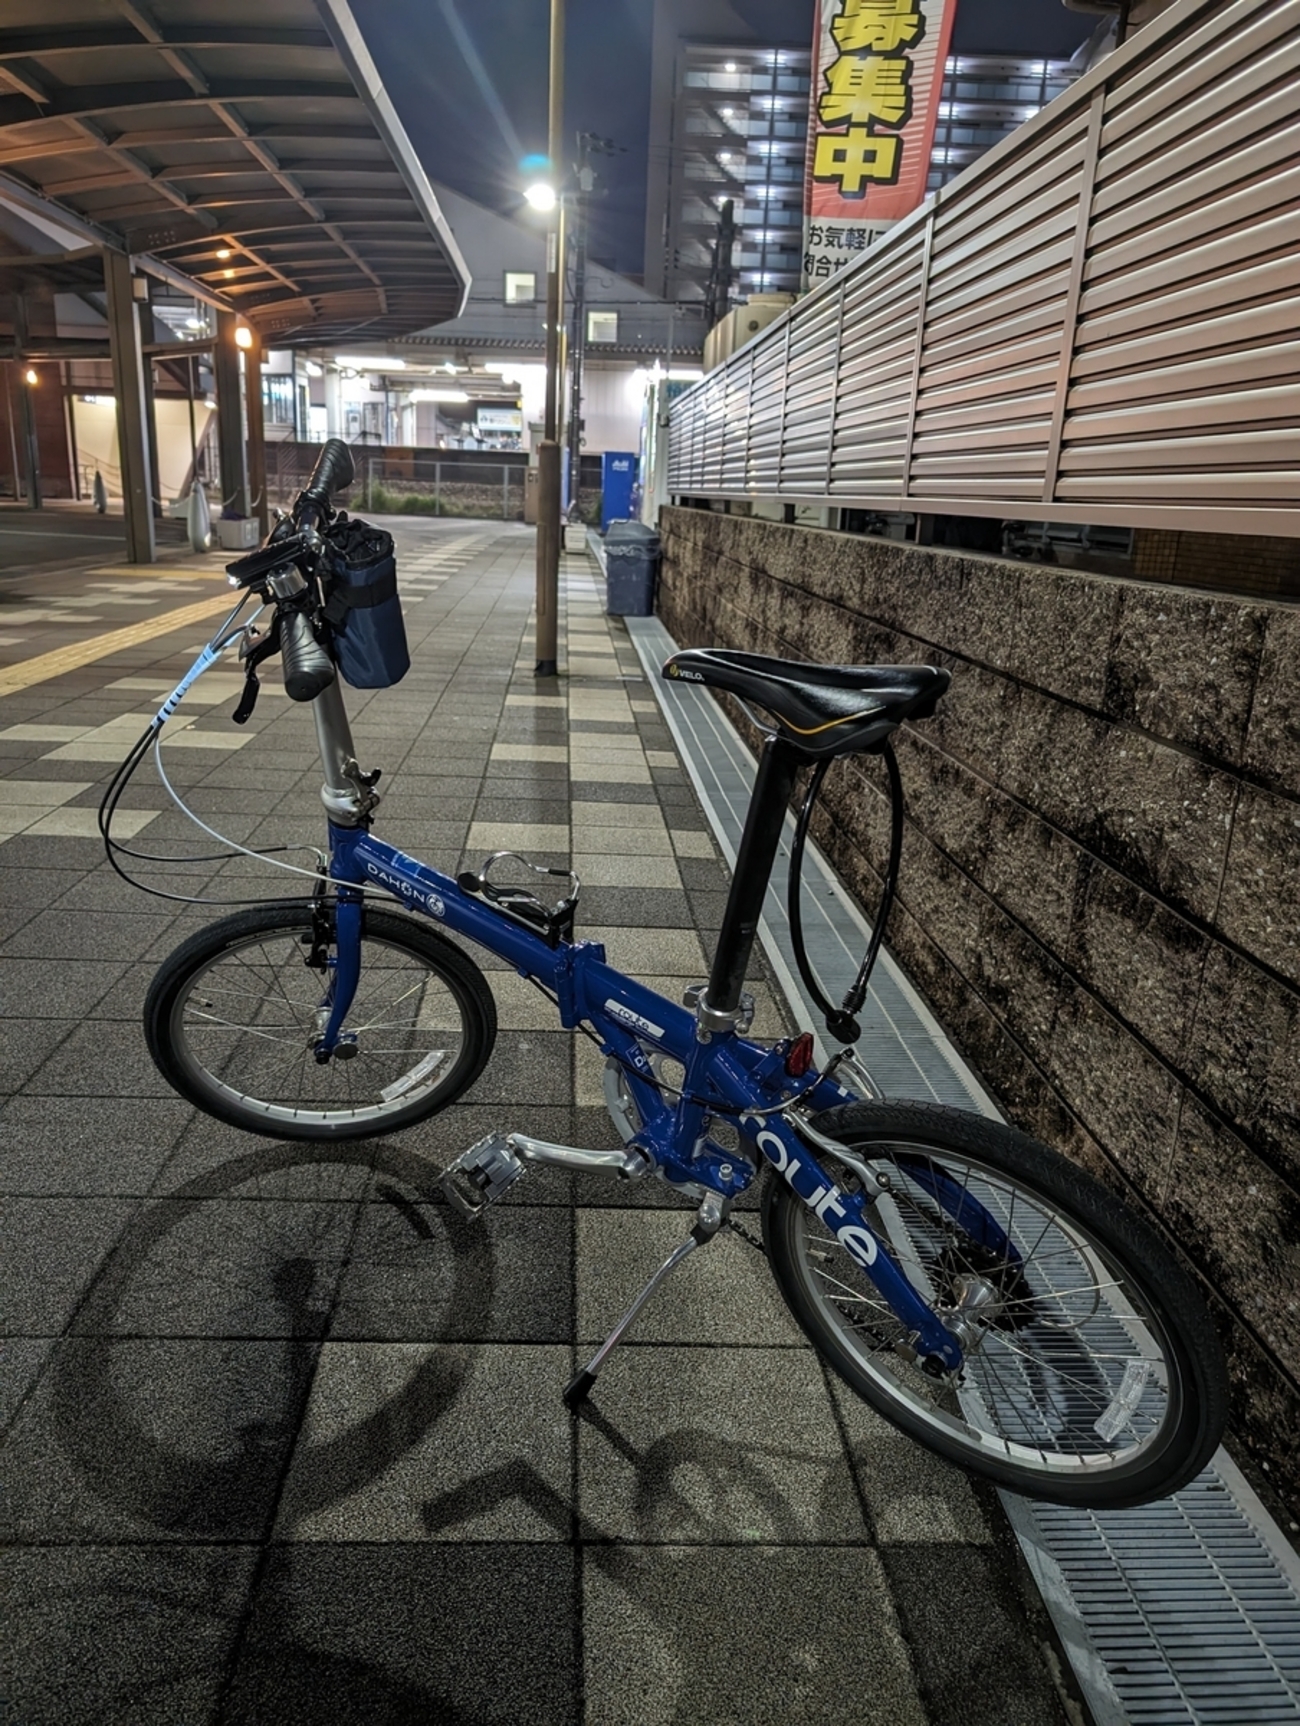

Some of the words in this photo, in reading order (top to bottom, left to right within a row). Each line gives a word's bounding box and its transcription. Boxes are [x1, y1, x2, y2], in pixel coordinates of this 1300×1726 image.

[813, 0, 926, 199] 募集中
[679, 669, 702, 680] VELO
[367, 862, 425, 903] DAHON
